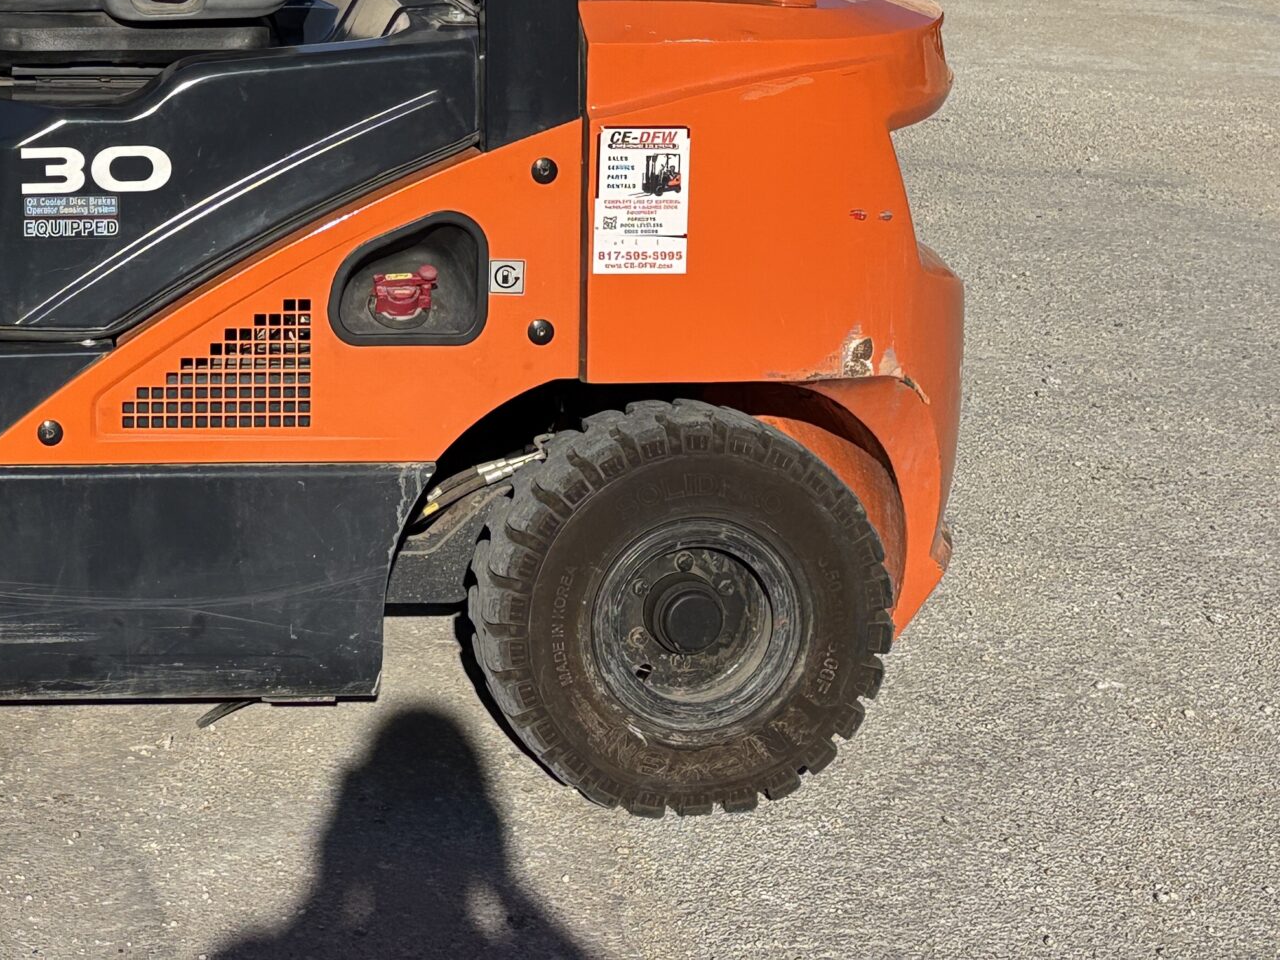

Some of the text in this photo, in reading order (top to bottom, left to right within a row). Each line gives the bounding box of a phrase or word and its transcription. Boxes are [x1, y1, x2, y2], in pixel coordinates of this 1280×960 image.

[609, 131, 678, 143] CE-DFW
[20, 145, 172, 194] 30
[69, 196, 87, 205] Disc
[23, 219, 119, 238] EQUIPPED
[551, 566, 578, 688] MADE IN KOREA
